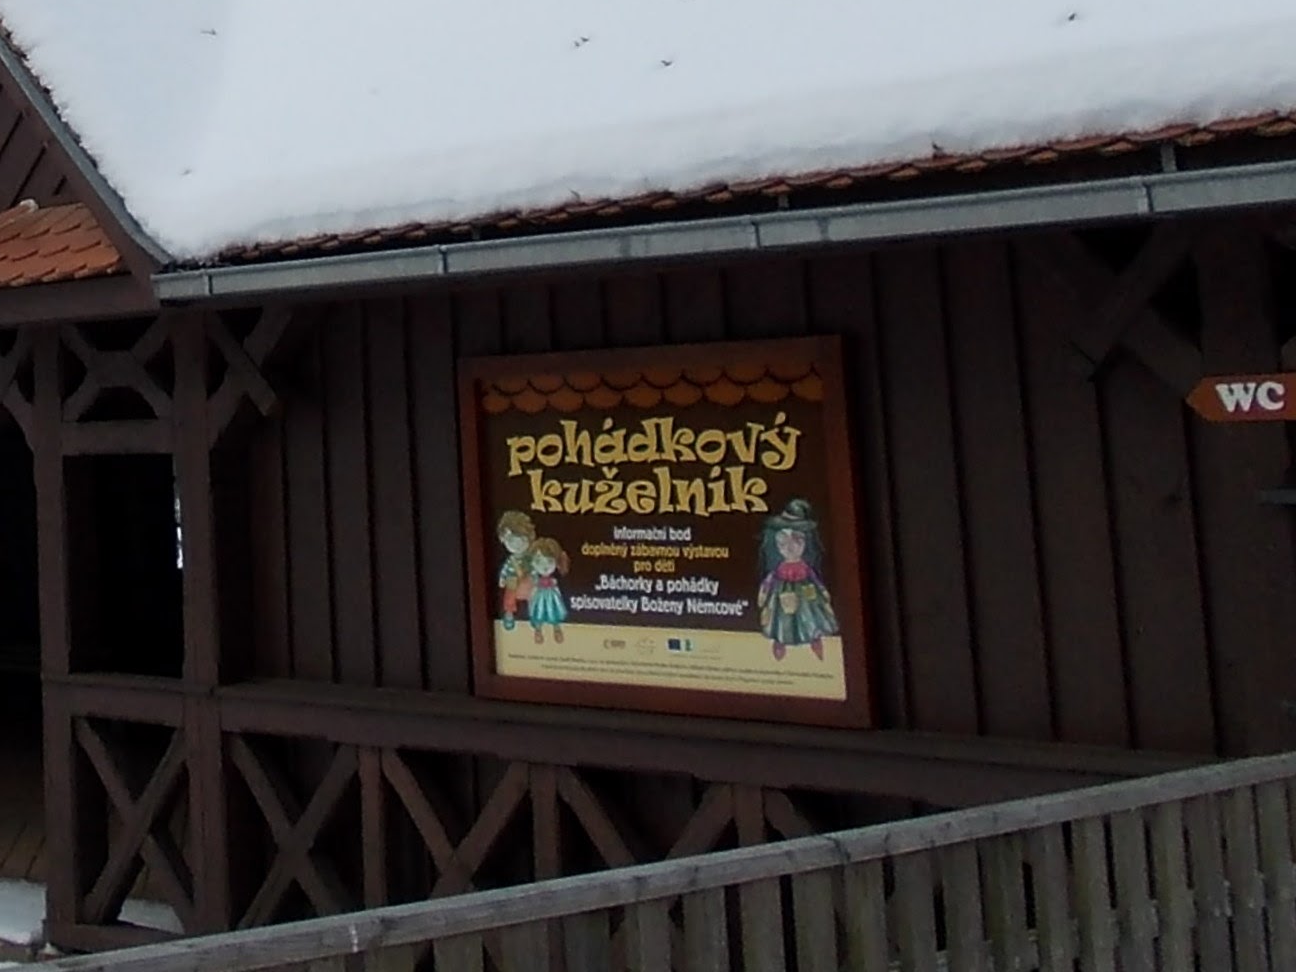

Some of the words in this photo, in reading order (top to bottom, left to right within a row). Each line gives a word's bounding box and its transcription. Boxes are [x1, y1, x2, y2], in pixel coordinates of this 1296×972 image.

[1215, 381, 1285, 413] WC
[507, 412, 802, 476] pohádkový
[526, 465, 768, 516] kuželník
[669, 527, 692, 541] bod
[581, 542, 628, 558] doplněný
[630, 544, 680, 558] zábavnou
[683, 543, 729, 559] výstavou
[633, 561, 653, 573] pro
[655, 579, 664, 591] a
[666, 576, 719, 596] pohádky
[570, 595, 638, 614] spisovatelky
[640, 597, 684, 616] Boženy
